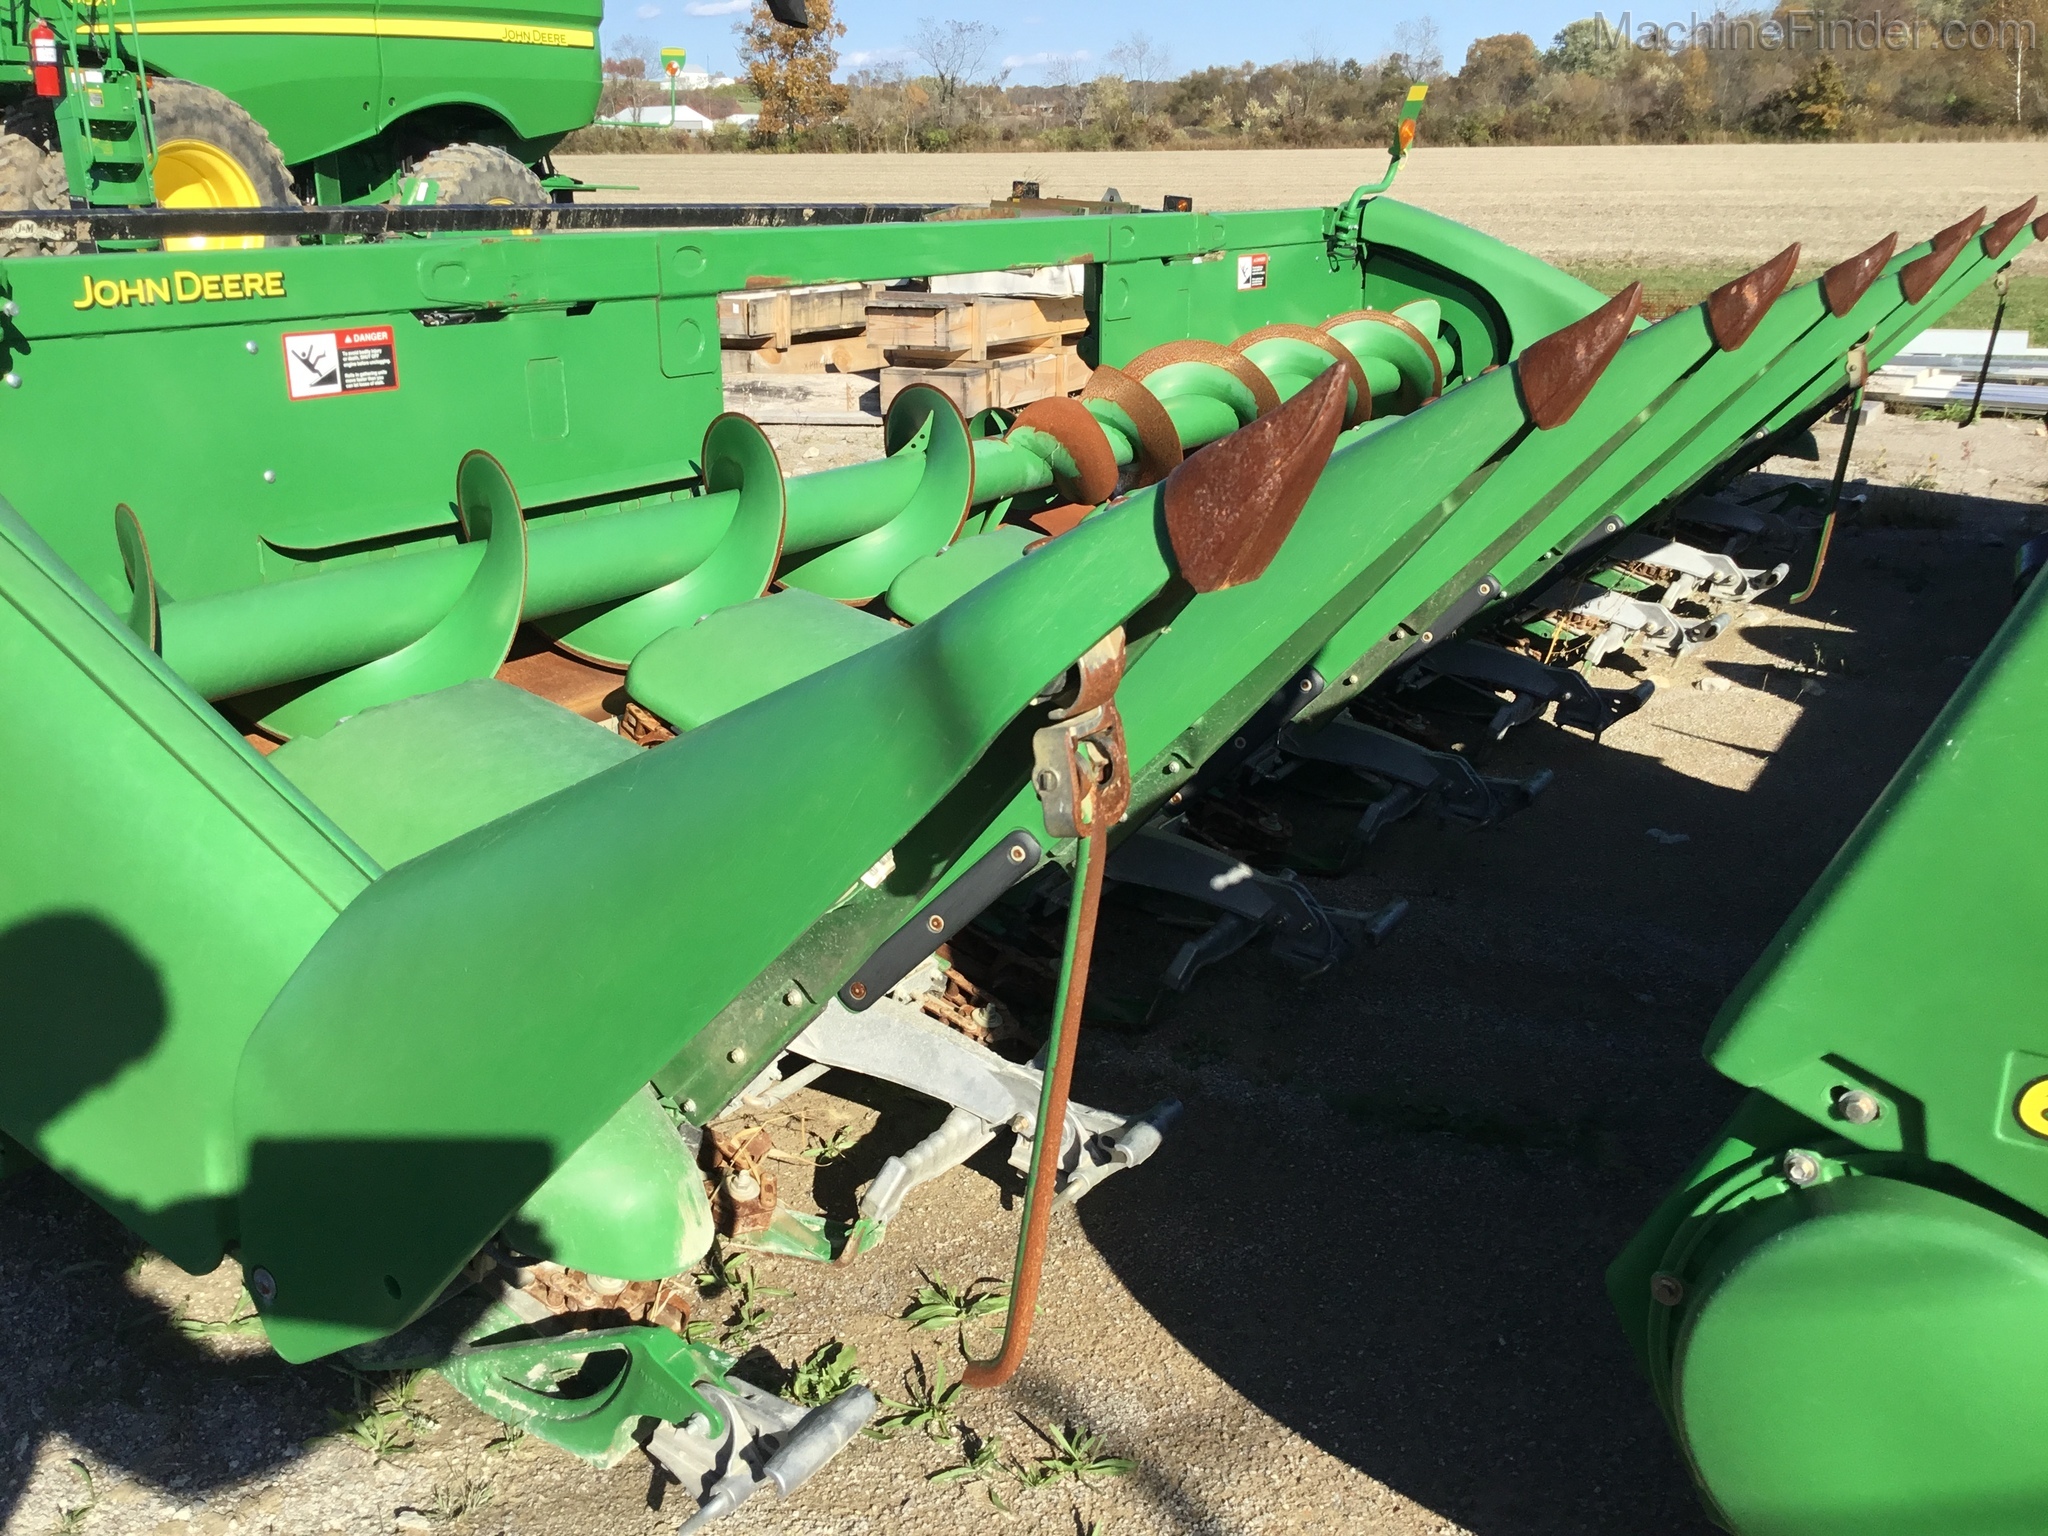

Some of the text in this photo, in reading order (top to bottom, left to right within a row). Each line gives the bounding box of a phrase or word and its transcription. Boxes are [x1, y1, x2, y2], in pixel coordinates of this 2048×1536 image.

[502, 28, 567, 44] JOHN DEERE
[73, 270, 286, 310] JOHN DEERE
[353, 331, 388, 343] DANGER
